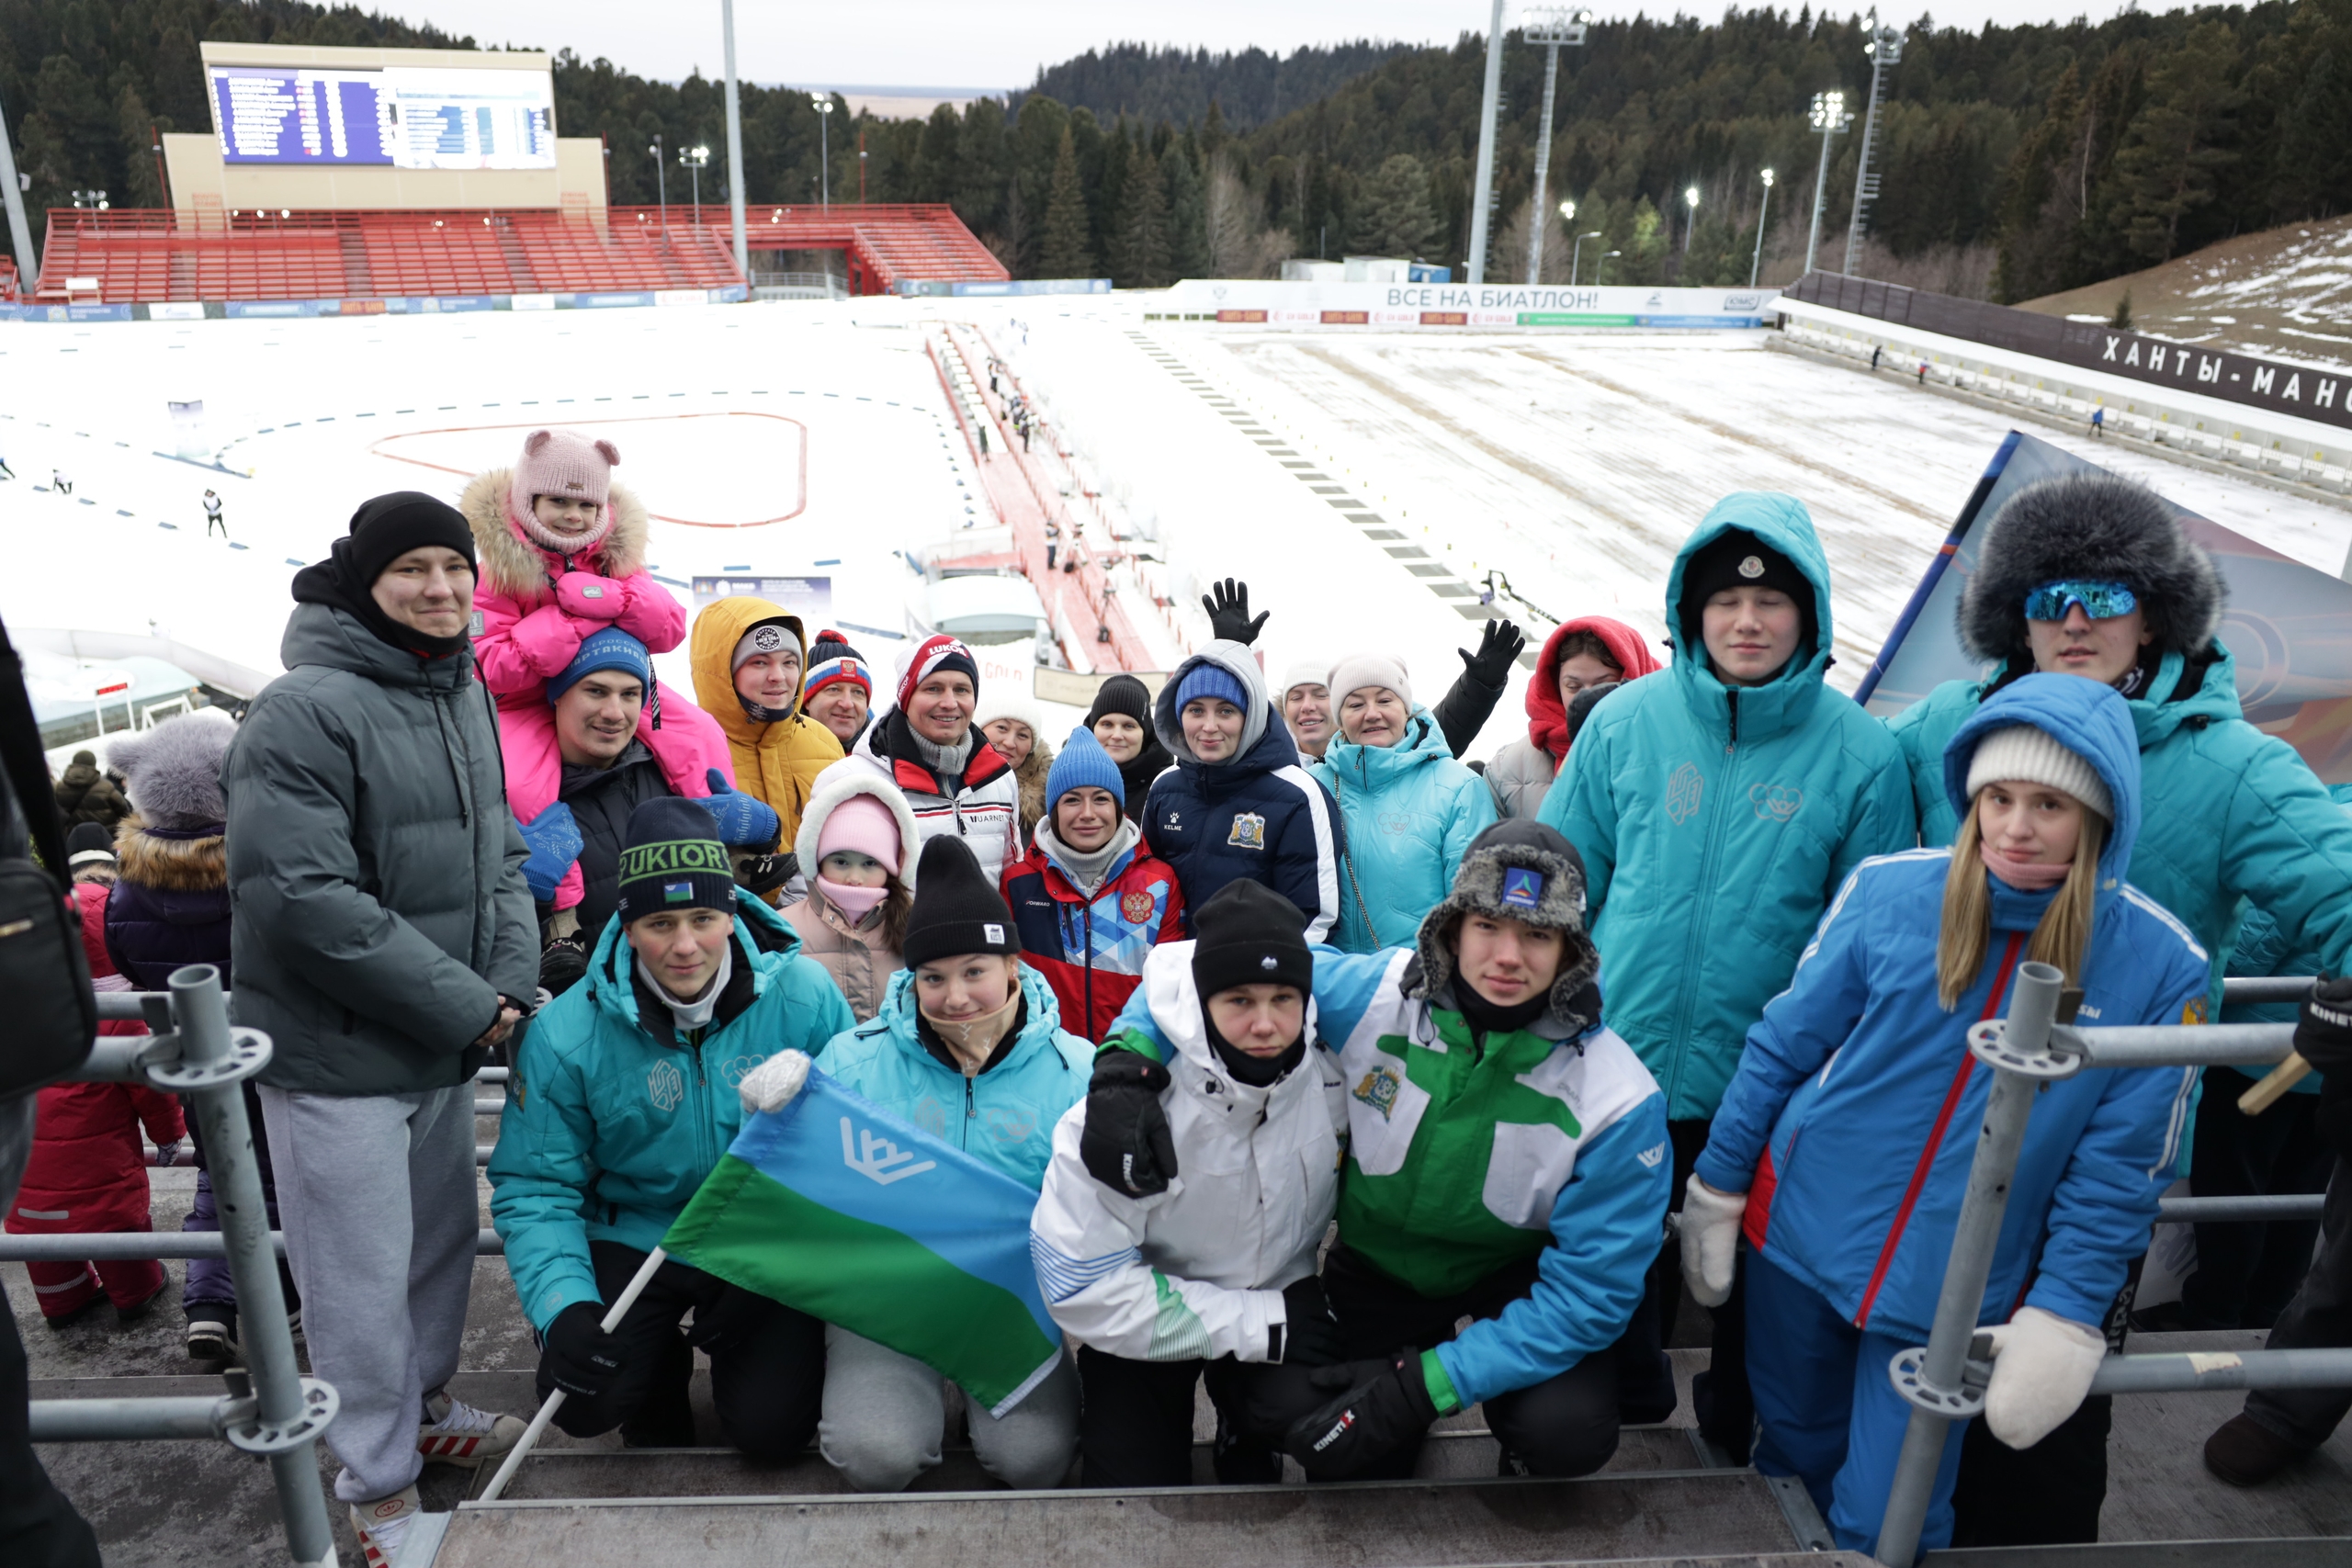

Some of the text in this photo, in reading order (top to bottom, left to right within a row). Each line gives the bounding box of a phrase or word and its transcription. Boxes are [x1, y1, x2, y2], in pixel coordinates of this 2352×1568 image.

[1387, 288, 1598, 309] ВСЕ НА БИАТЛОН!
[929, 644, 967, 657] LUKOIL
[1025, 899, 1050, 908] FORWARD
